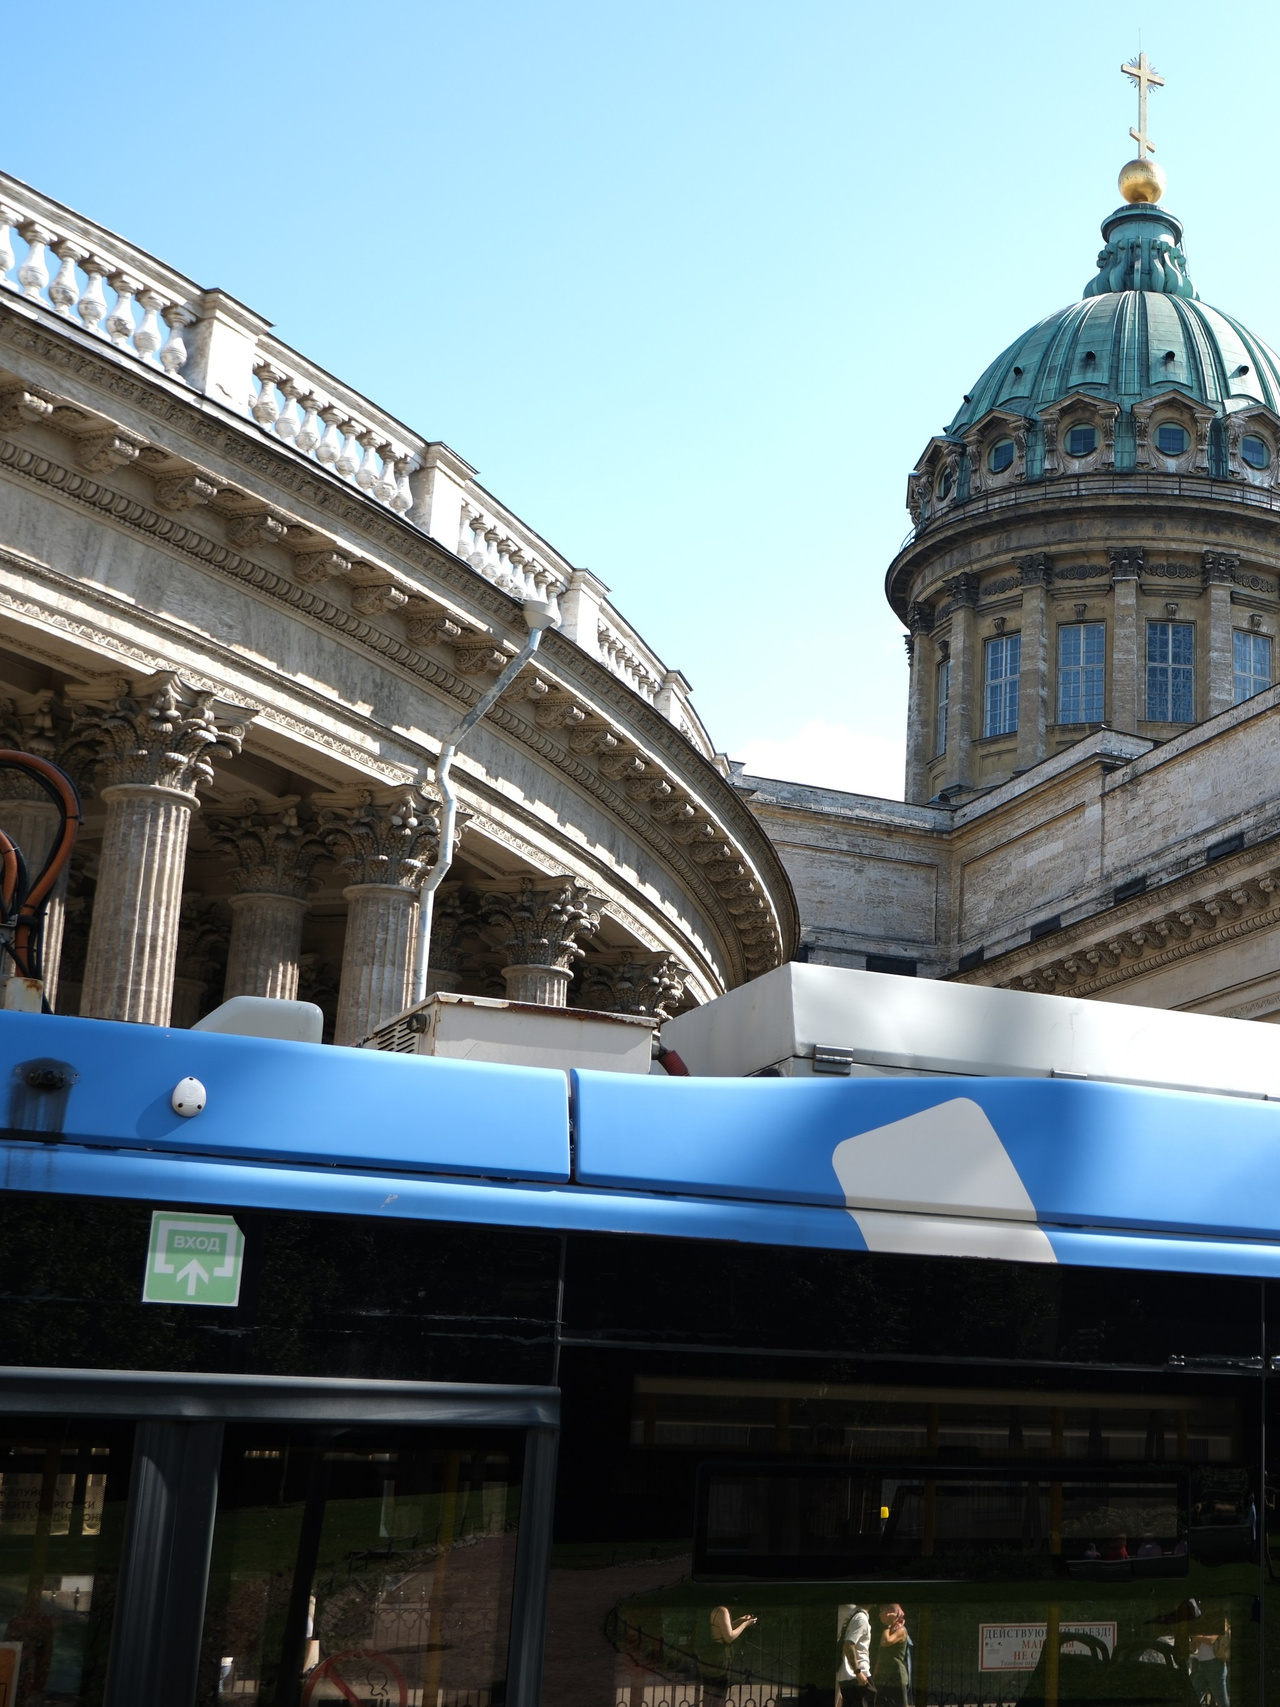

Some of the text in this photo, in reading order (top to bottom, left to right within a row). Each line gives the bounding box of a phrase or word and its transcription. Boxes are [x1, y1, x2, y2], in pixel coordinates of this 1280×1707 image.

[173, 1235, 220, 1253] ВХОД
[985, 1627, 1071, 1640] ДЕЙСТВУЮЙ
[1014, 1651, 1028, 1661] НЕ
